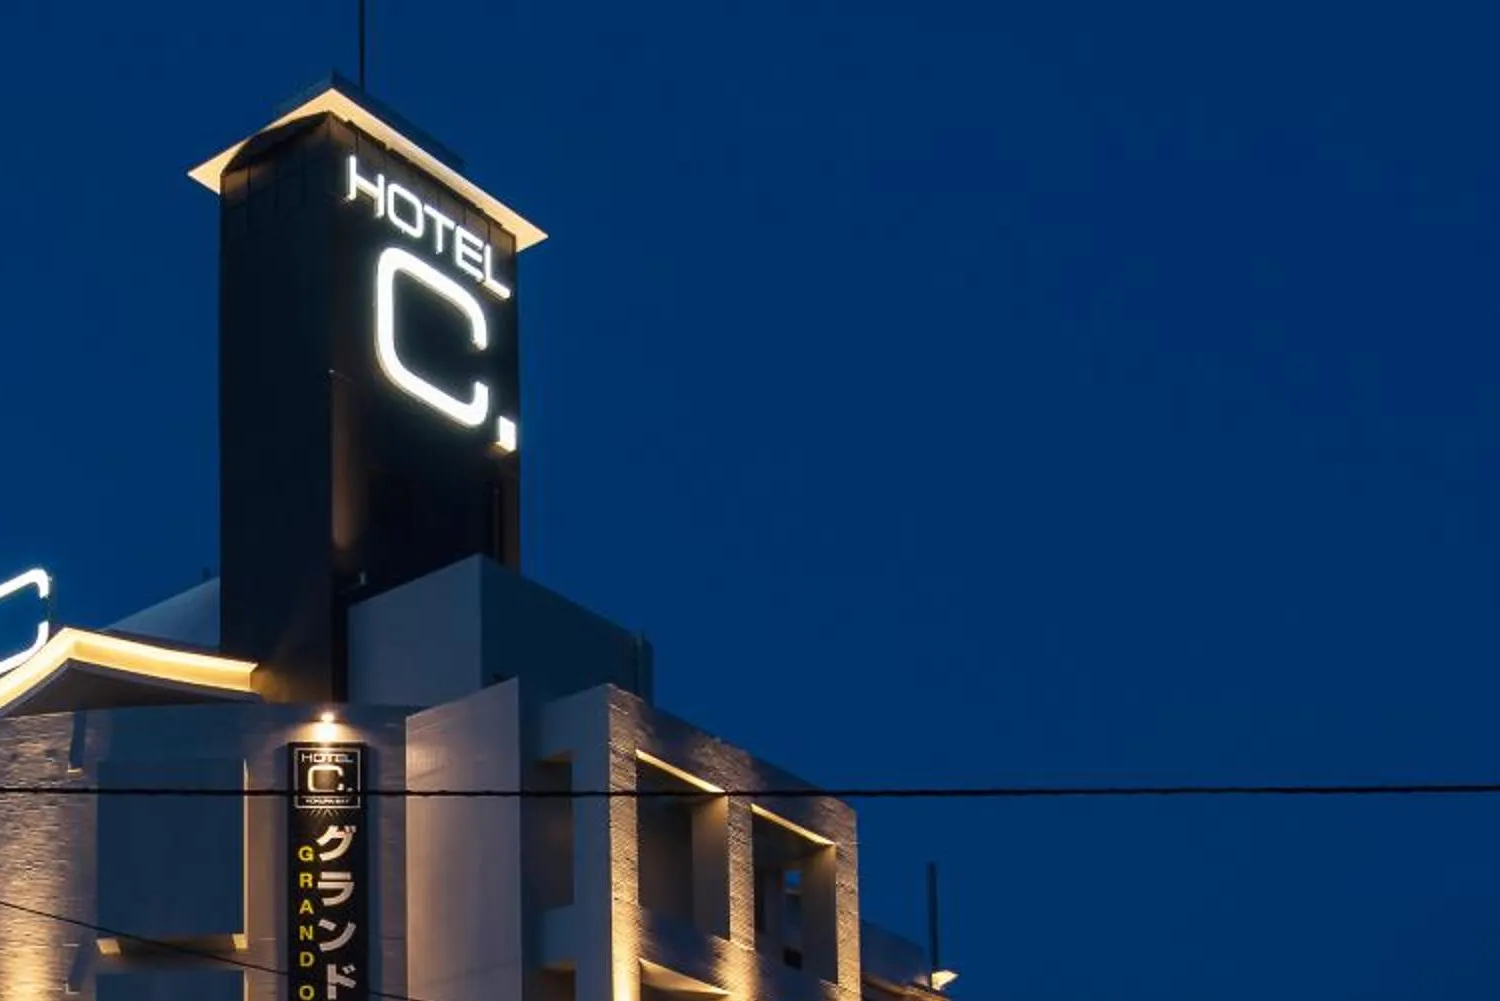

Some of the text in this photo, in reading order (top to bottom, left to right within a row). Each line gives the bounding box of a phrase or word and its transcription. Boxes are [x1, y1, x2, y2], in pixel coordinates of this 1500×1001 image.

[346, 154, 511, 299] HOTEL
[301, 752, 354, 763] HOTEL
[297, 845, 316, 968] GRAND
